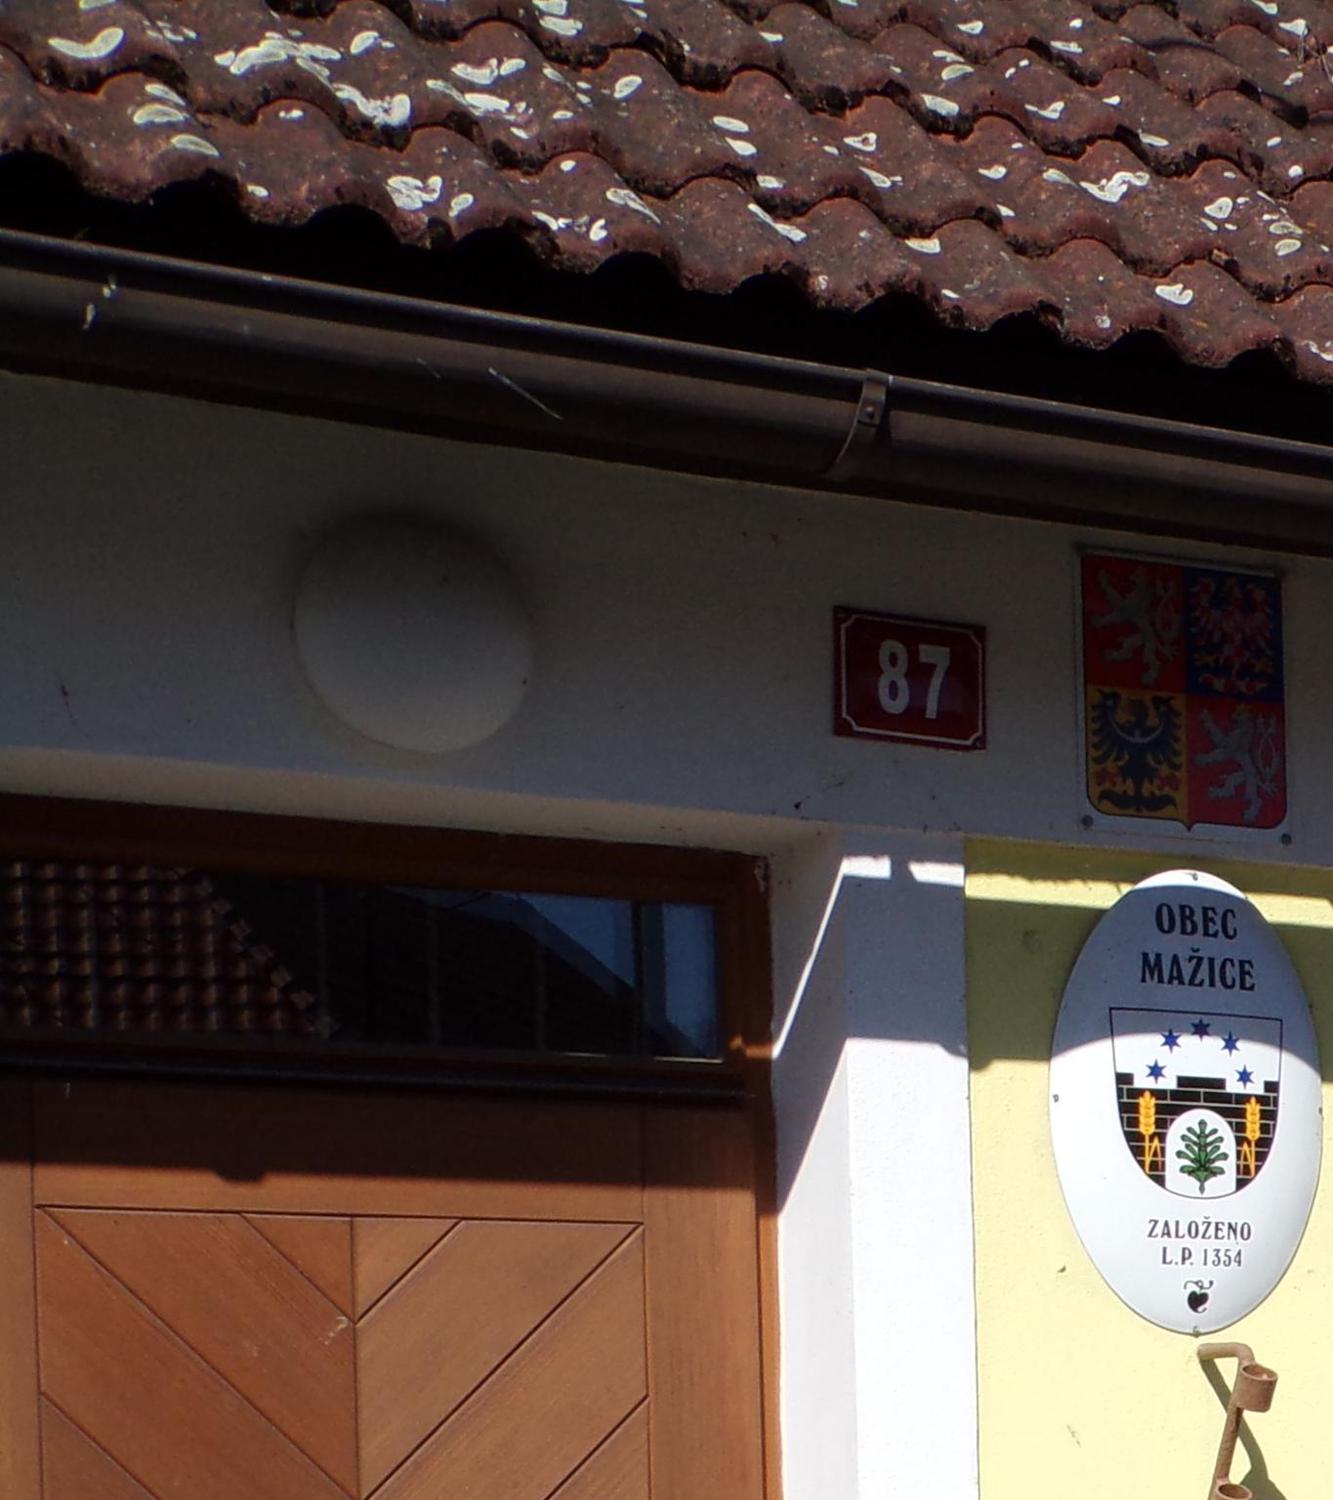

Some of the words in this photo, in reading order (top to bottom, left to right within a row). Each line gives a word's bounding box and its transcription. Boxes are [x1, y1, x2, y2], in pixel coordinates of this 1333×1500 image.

[877, 639, 951, 720] 87
[1154, 902, 1238, 941] OBEC
[1139, 947, 1257, 992] MAŽICE
[1146, 1215, 1252, 1242] ZALOŽENO
[1161, 1246, 1194, 1267] L.P.
[1202, 1248, 1243, 1268] 1354
